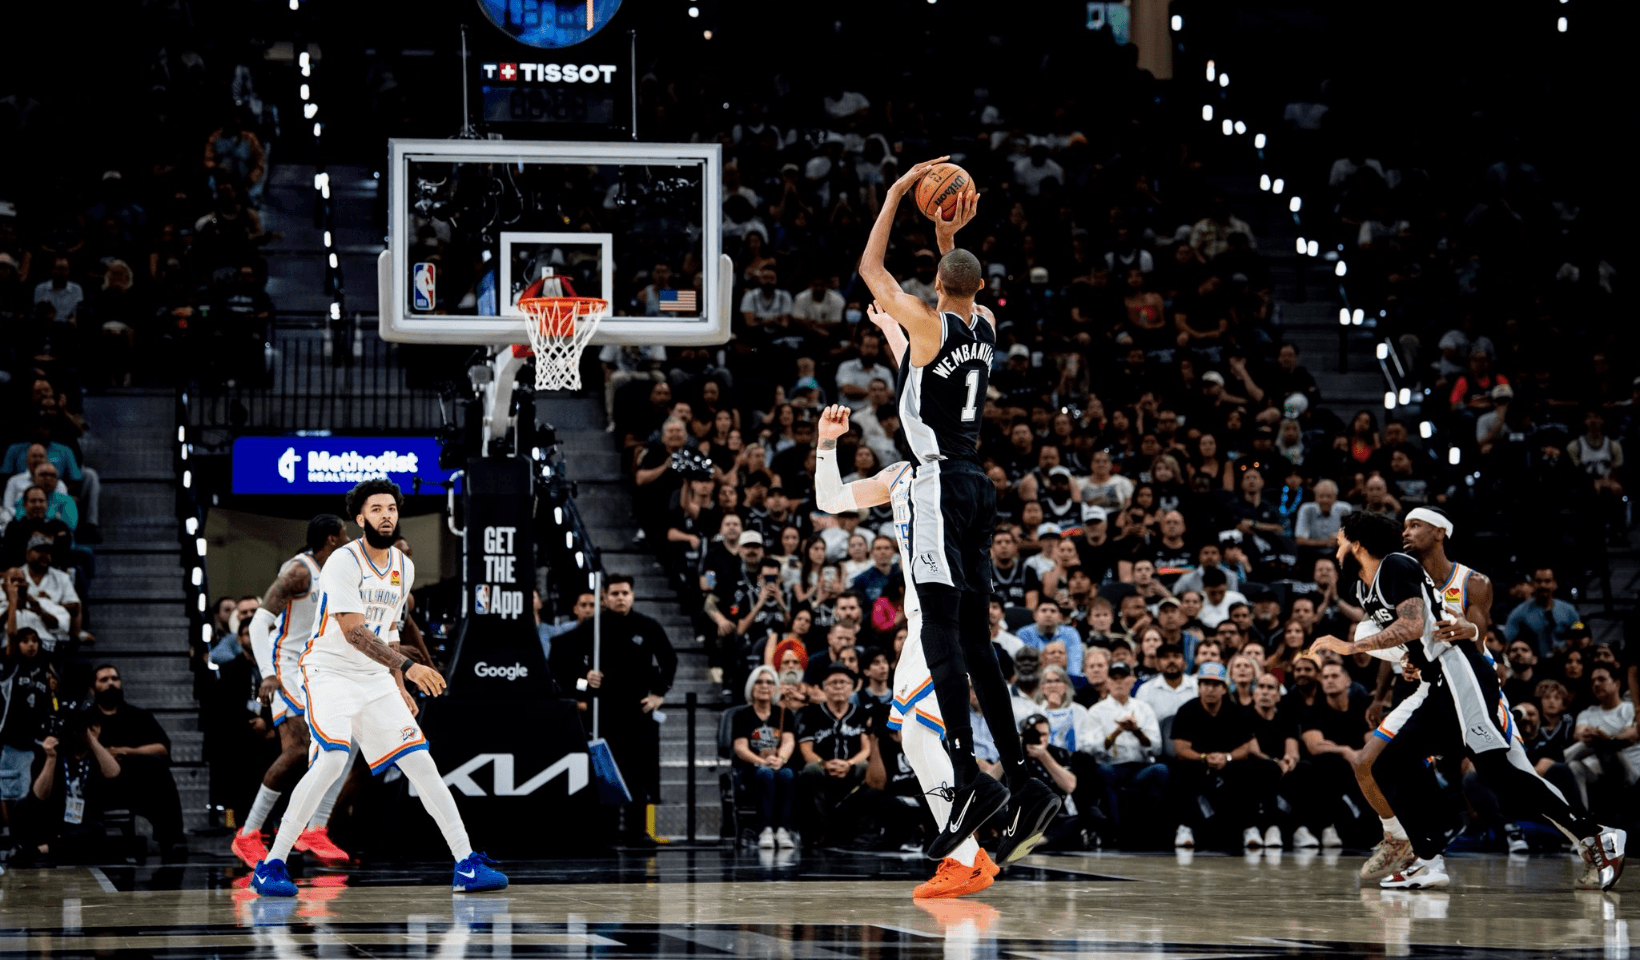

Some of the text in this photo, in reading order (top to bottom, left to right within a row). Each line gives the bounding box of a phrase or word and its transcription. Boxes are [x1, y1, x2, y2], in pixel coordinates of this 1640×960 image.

[519, 63, 617, 84] TISSOT
[934, 175, 965, 206] Wilson
[960, 369, 980, 422] 1
[308, 451, 418, 473] Methodist
[483, 526, 517, 554] GET
[483, 555, 517, 583] THE
[490, 584, 524, 620] App
[474, 661, 529, 681] Google
